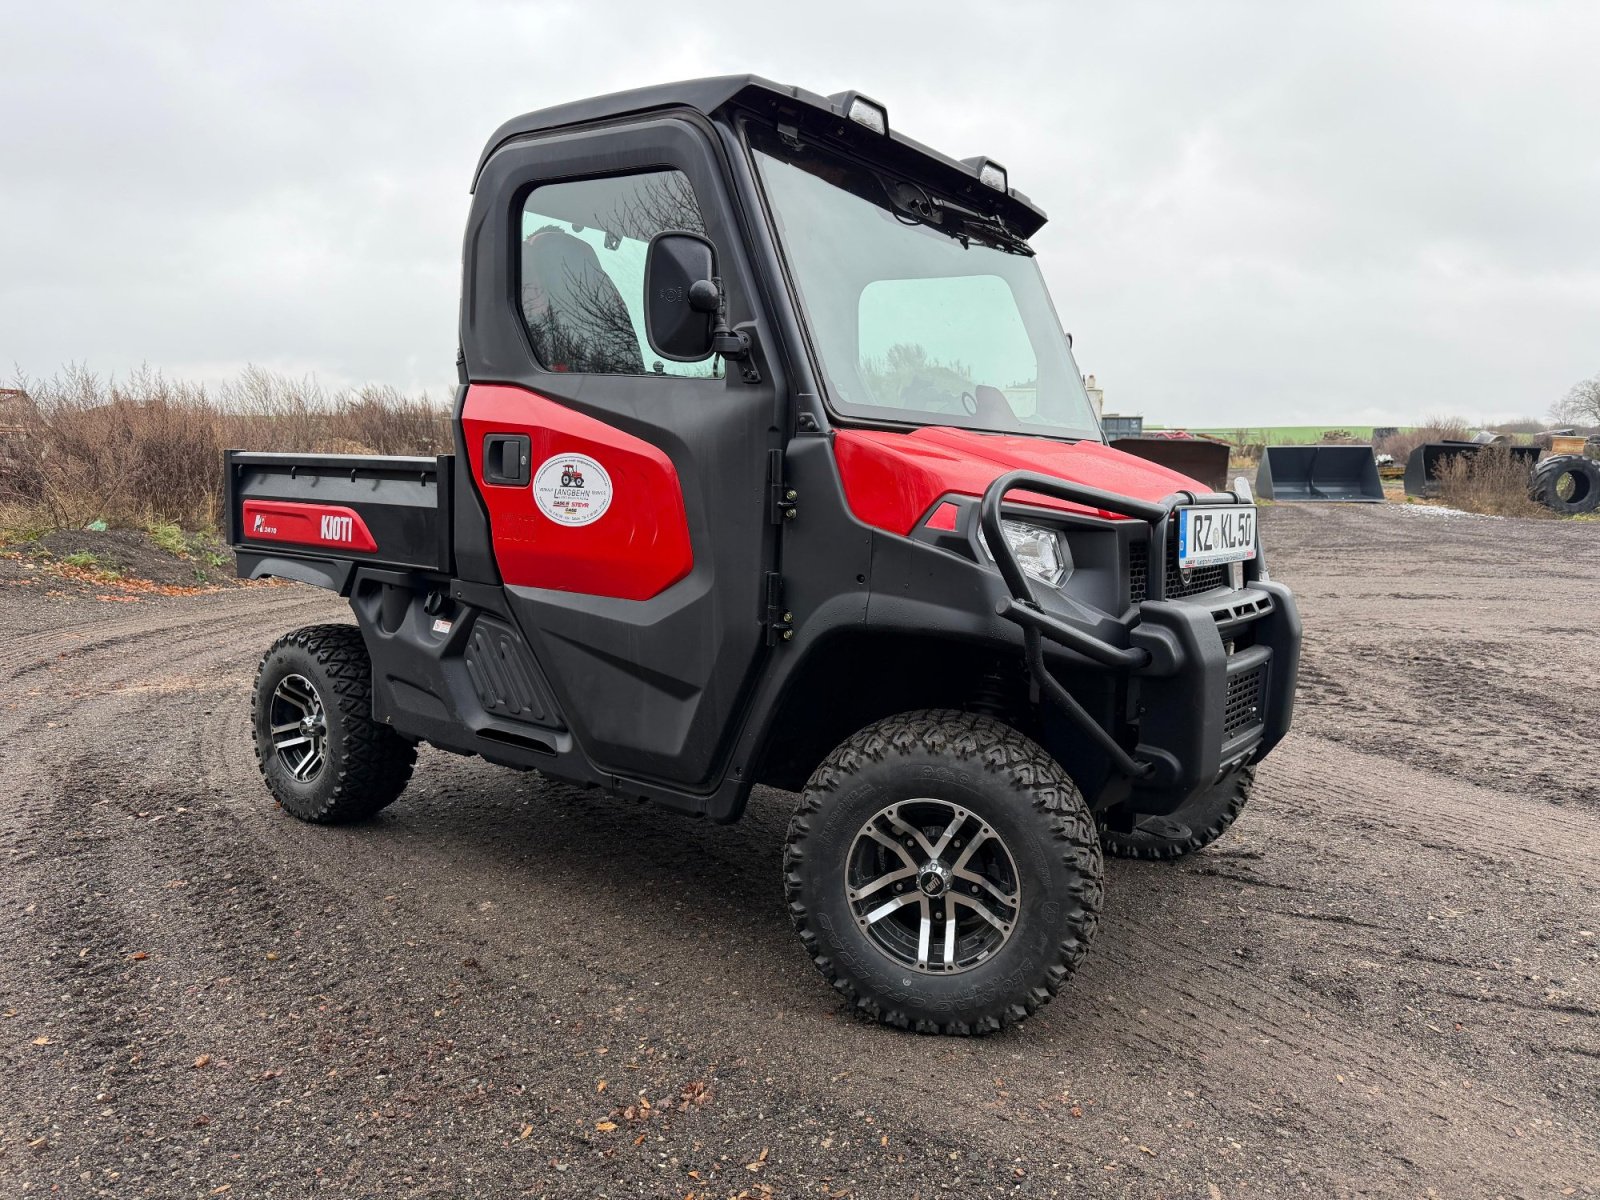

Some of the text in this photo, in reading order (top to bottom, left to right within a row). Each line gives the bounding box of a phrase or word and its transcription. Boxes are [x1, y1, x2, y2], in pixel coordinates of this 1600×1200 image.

[553, 488, 590, 499] LANGBEHN
[320, 515, 353, 543] KIOTI
[1193, 513, 1252, 552] RZ KL 50
[925, 876, 941, 893] KIOTI
